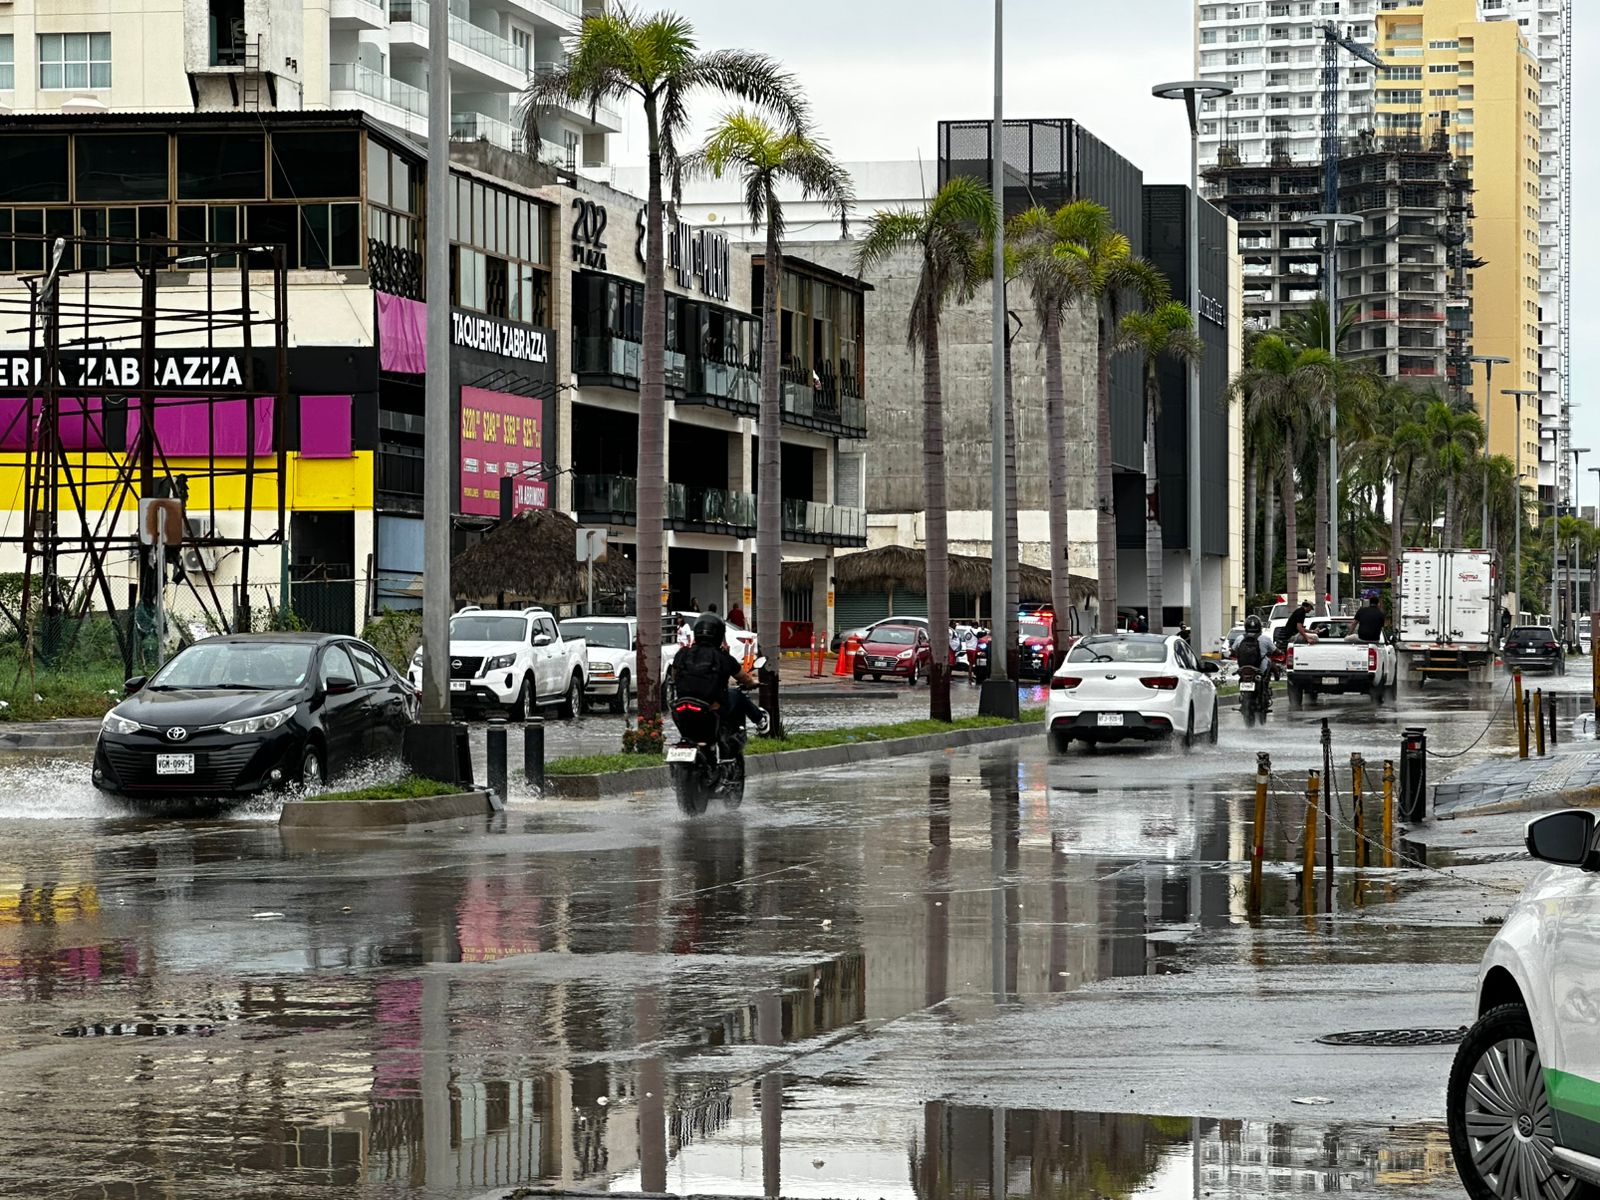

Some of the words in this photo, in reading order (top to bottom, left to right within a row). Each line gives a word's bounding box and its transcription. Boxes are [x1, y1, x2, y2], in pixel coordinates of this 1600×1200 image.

[572, 197, 607, 248] 202
[573, 244, 607, 270] PLAZA
[452, 312, 502, 355] TAQUERIA
[502, 325, 548, 363] ZABRAZZA
[78, 356, 243, 386] ZABAZZA
